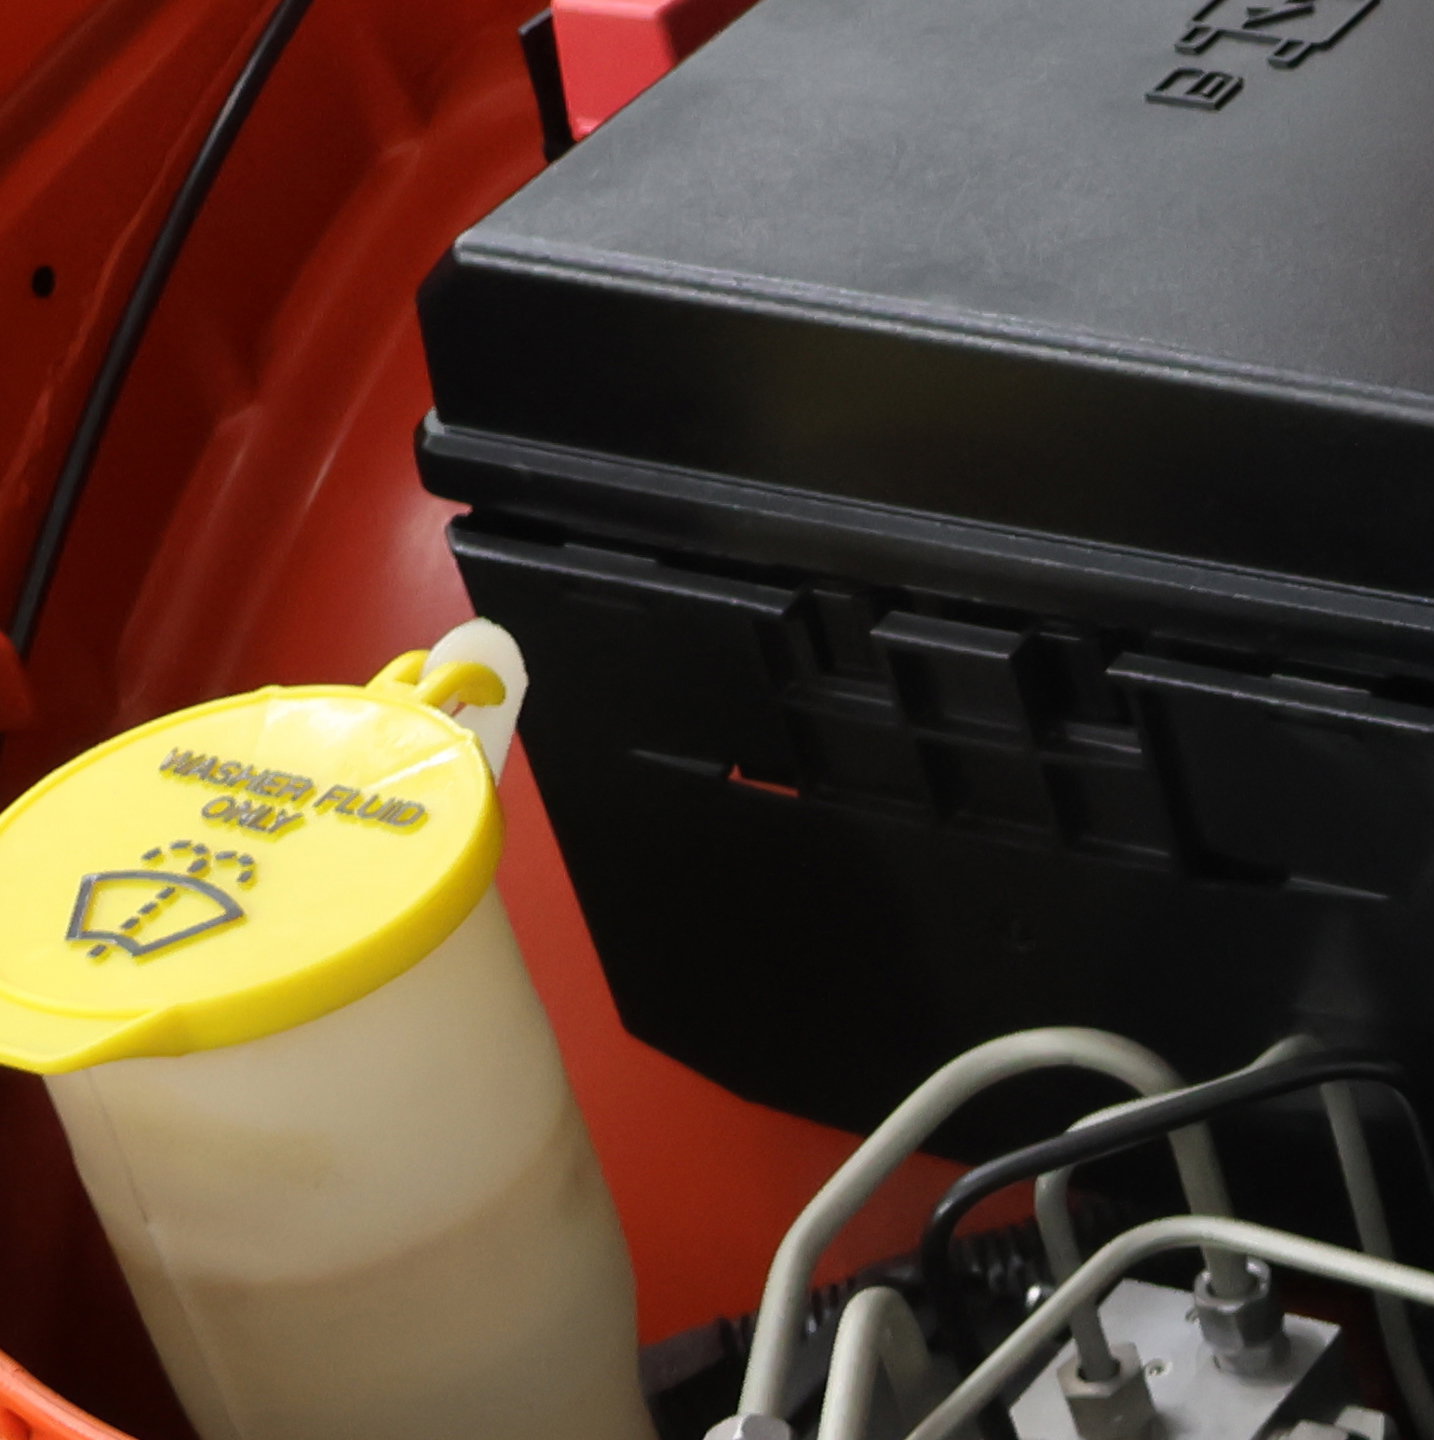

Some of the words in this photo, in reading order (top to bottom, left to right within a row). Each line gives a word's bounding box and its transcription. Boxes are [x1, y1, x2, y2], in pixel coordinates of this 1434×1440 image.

[158, 747, 315, 803] WASHER
[314, 785, 428, 827] FLUID
[201, 796, 303, 835] ONLY
